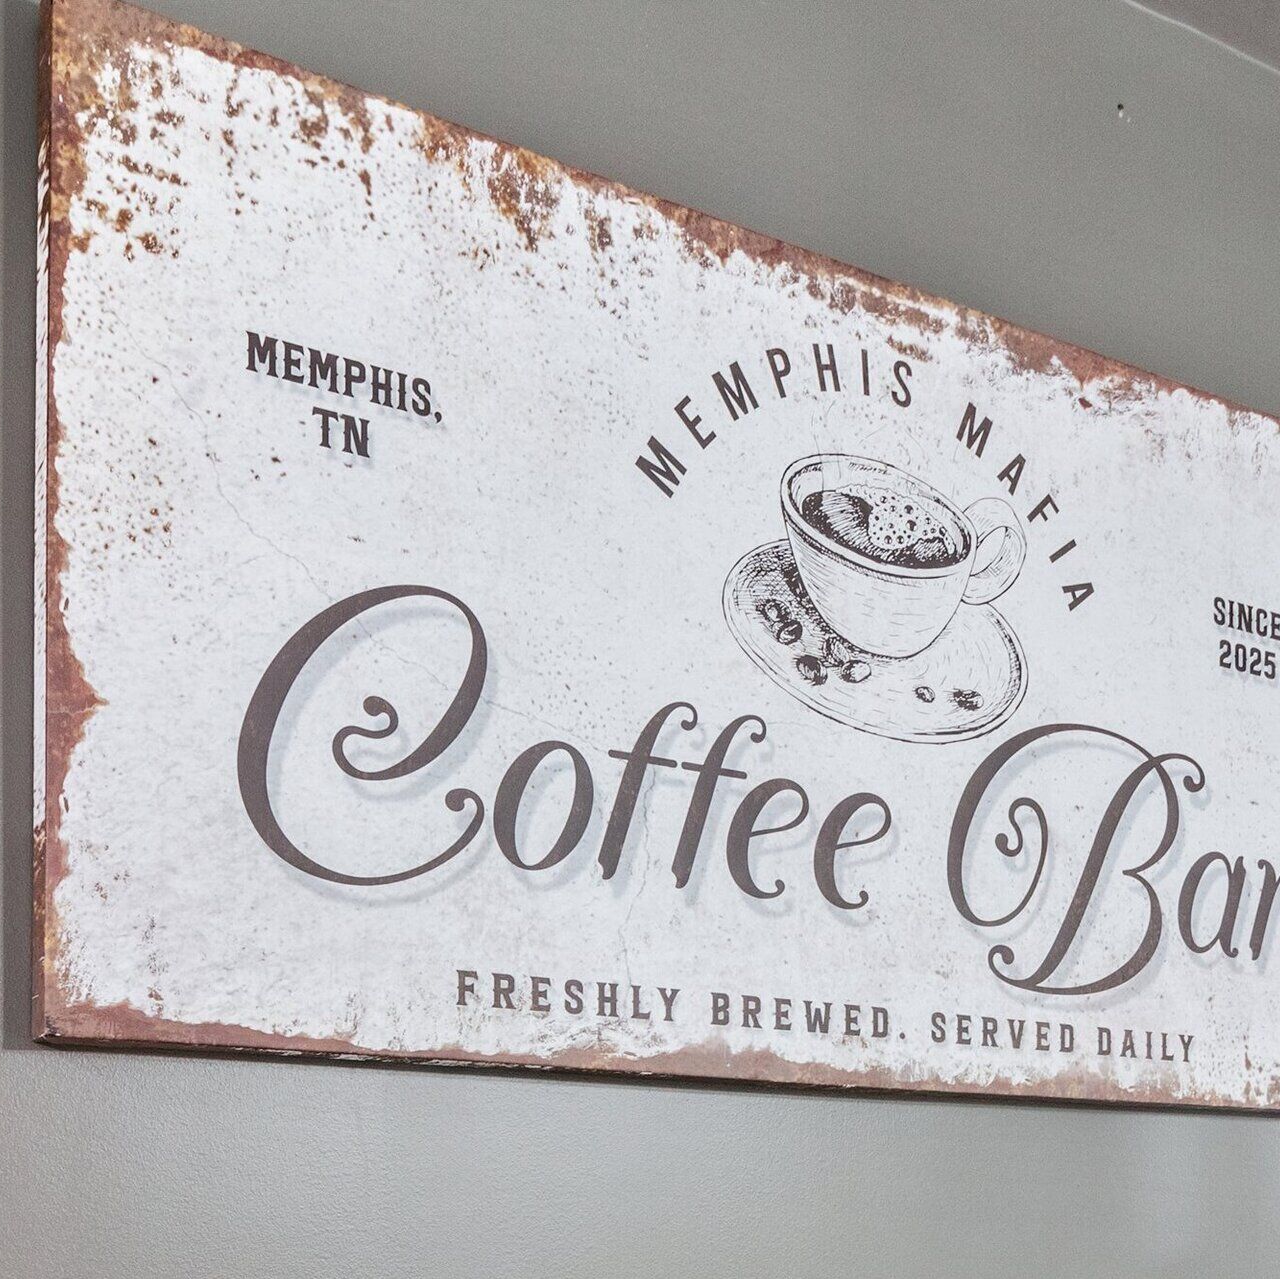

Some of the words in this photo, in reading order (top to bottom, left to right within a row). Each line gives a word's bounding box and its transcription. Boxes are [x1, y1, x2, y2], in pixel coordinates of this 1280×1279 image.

[245, 330, 443, 424] MEMPHIS,
[312, 406, 370, 458] TN
[635, 342, 913, 498] MEMPHIS
[956, 402, 1095, 612] MAFIA
[1218, 639, 1278, 680] 2025
[237, 584, 892, 910] Coffee
[455, 968, 679, 1022] FRESHLY
[711, 991, 906, 1040] BREWED.
[930, 1011, 1075, 1054] SERVED
[1097, 1026, 1195, 1063] DAILY
